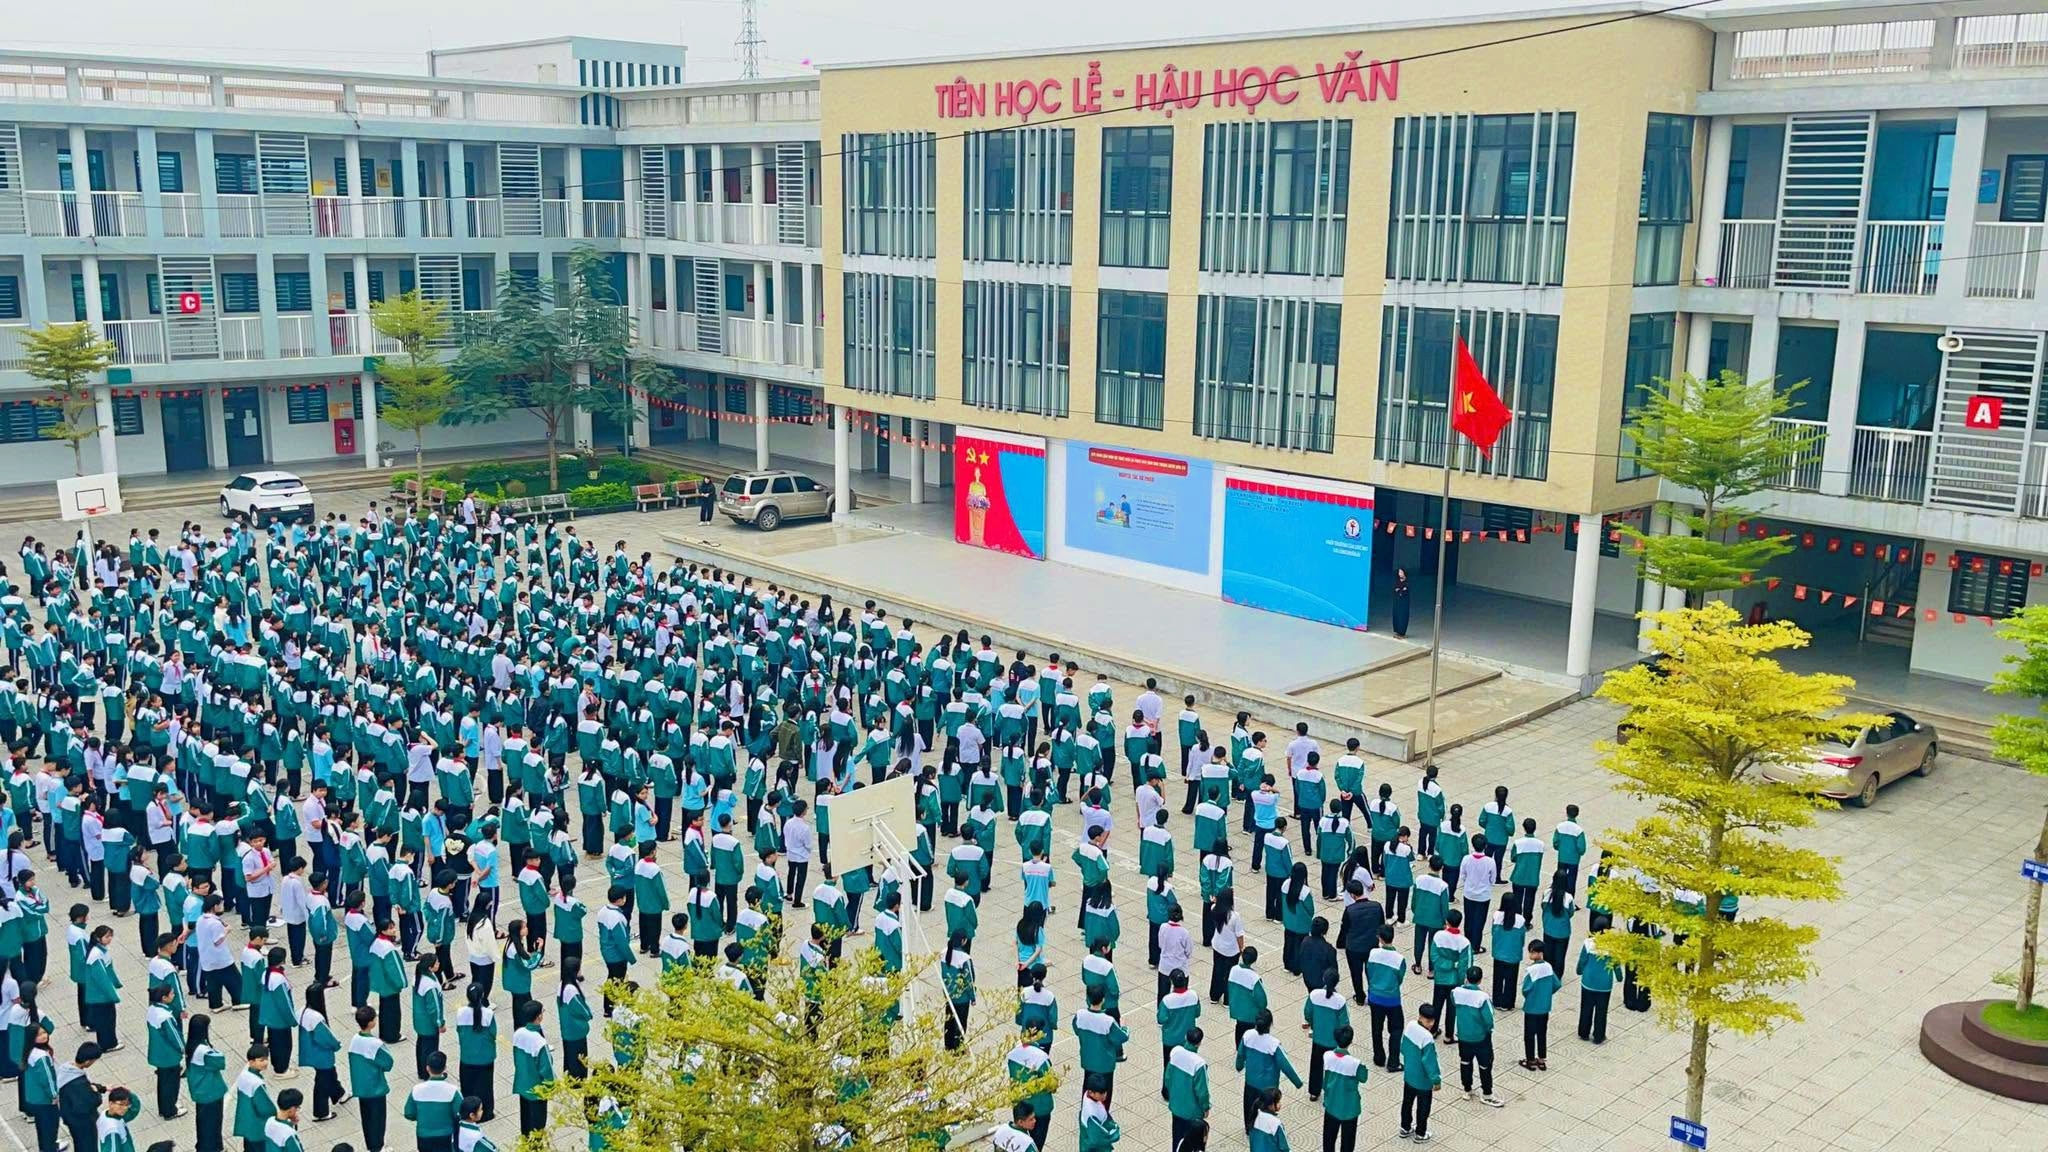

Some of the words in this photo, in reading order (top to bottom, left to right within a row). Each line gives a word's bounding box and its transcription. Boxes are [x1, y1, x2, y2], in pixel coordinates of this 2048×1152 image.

[935, 76, 985, 118] TIÊN
[995, 78, 1062, 123] HỌC
[1073, 61, 1102, 113] LỄ
[1113, 89, 1124, 97] -
[1135, 63, 1202, 119] HẬU
[1213, 65, 1300, 115] HỌC
[1315, 50, 1399, 103] VĂN
[185, 296, 196, 310] C
[1973, 402, 1992, 424] A
